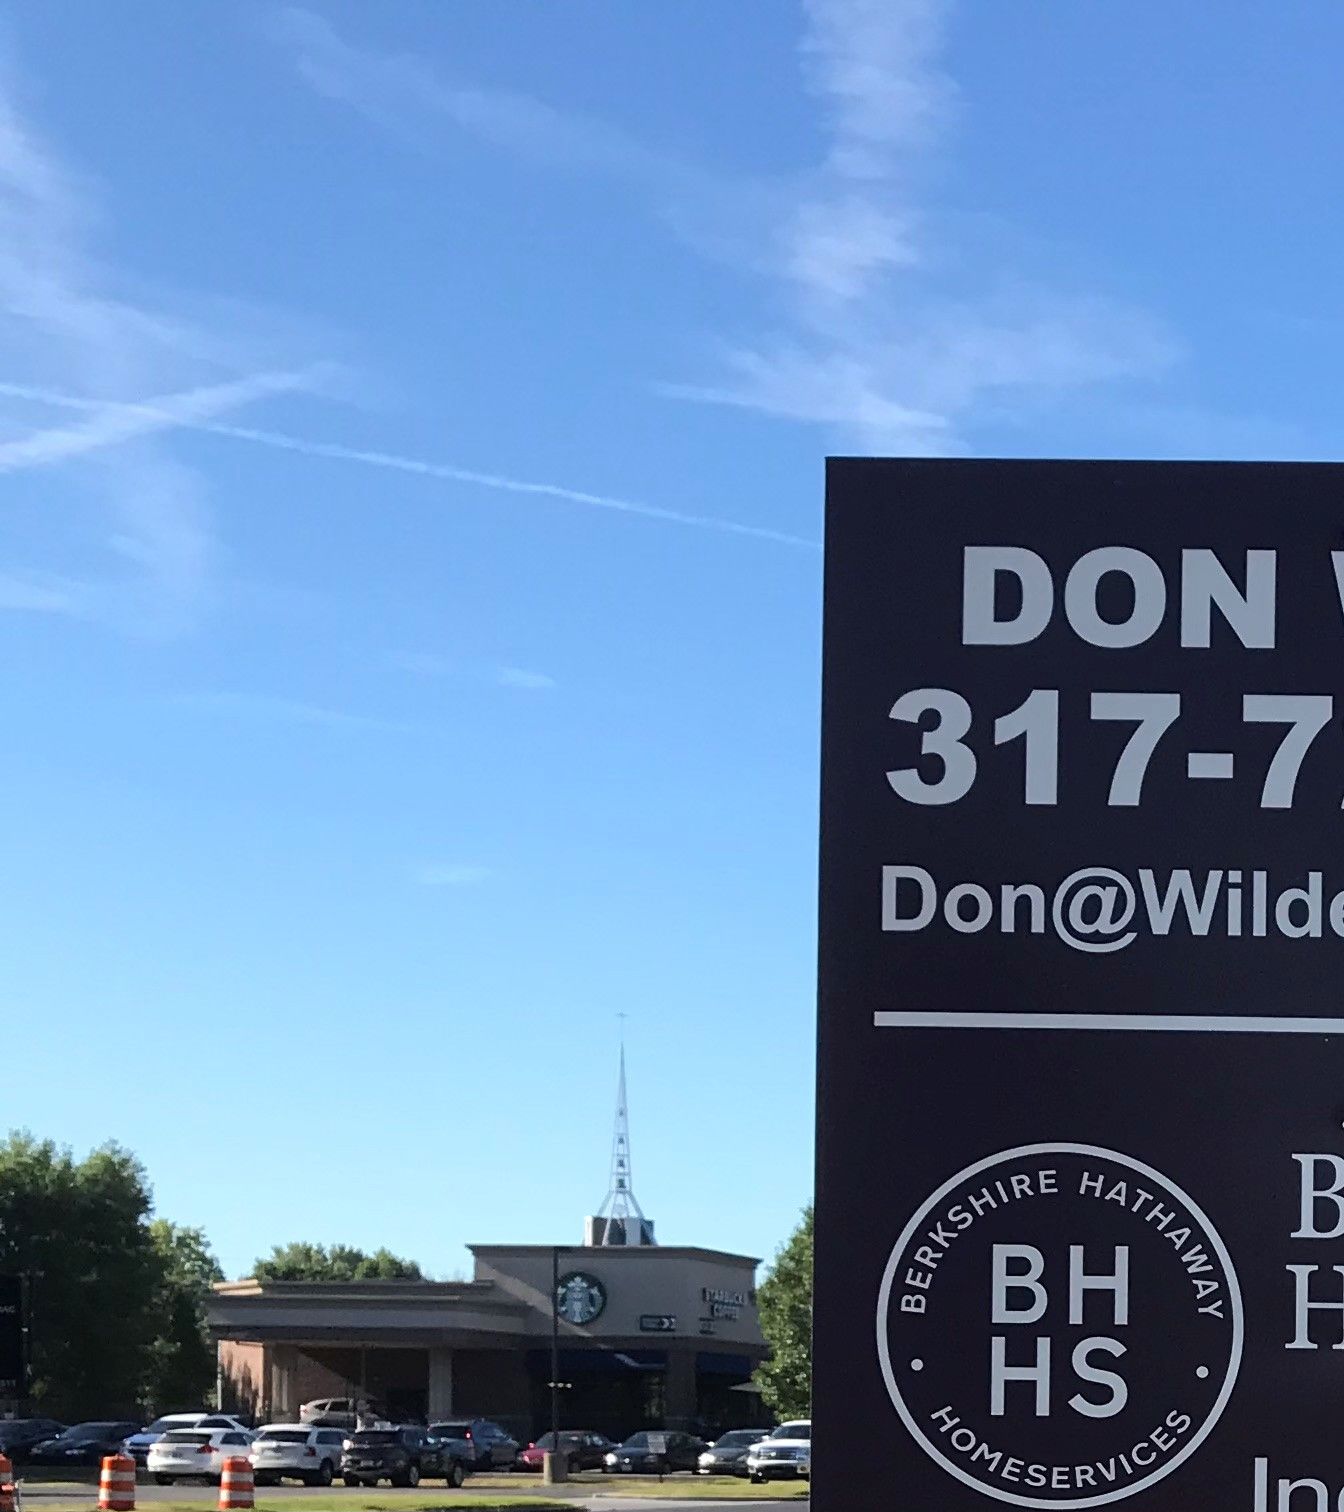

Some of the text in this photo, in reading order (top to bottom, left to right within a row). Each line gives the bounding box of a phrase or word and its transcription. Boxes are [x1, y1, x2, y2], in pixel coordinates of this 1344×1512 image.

[963, 546, 1276, 648] DON
[901, 1169, 1224, 1319] BERKSHIRE HATHAWAY
[992, 1244, 1128, 1325] BH
[991, 1337, 1127, 1418] HS
[930, 1405, 1191, 1490] HOMESERVICES
